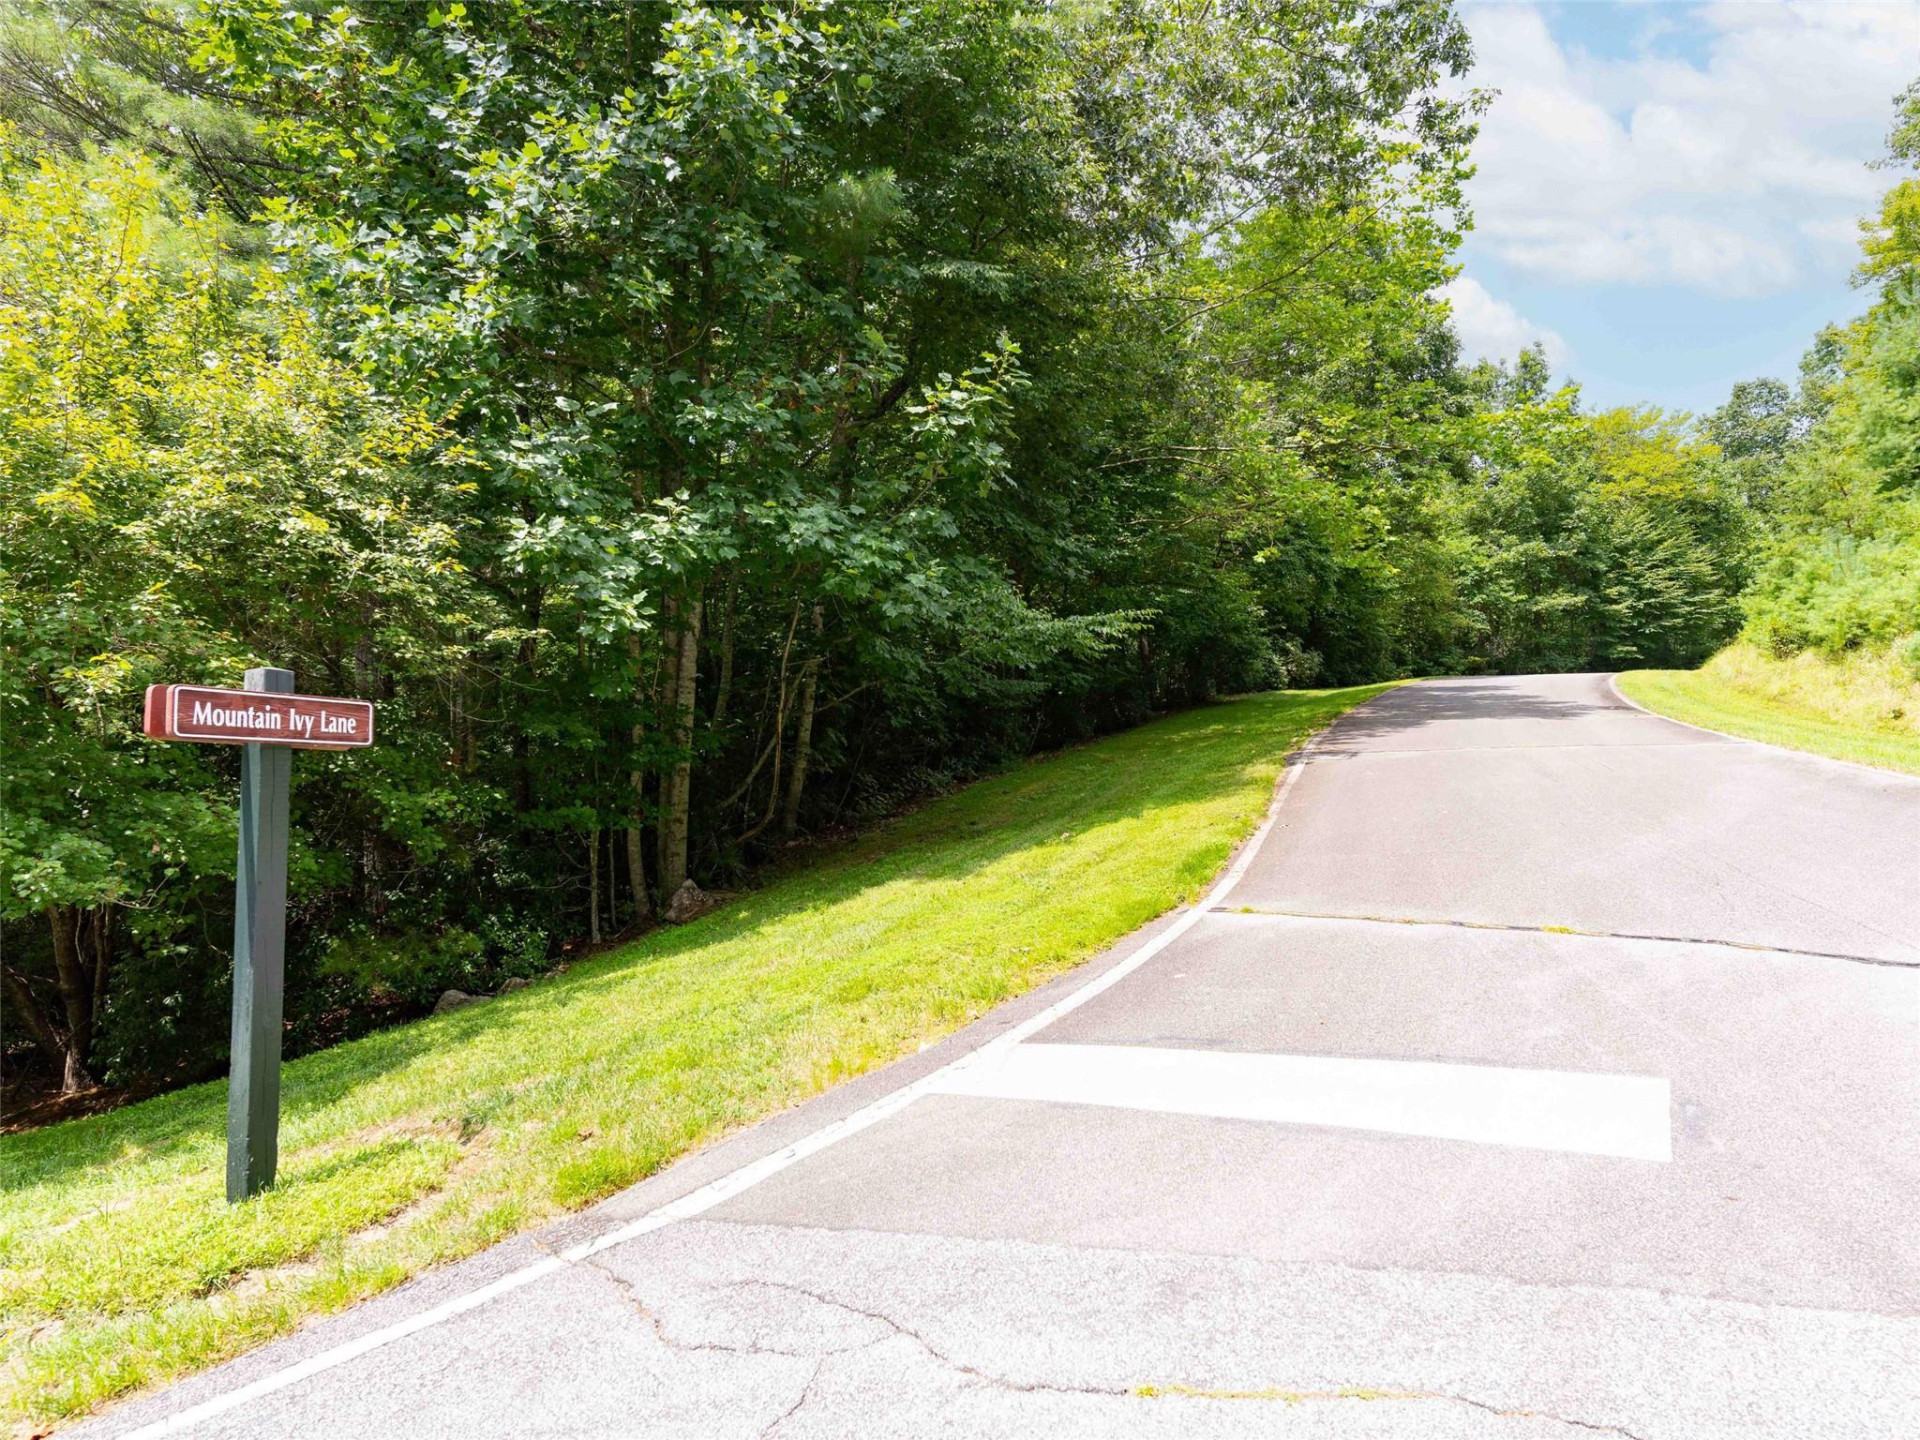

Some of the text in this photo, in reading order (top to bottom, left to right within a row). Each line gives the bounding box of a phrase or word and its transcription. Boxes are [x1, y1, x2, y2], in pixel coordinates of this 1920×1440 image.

[192, 701, 357, 738] Mountain Ivy Lane
